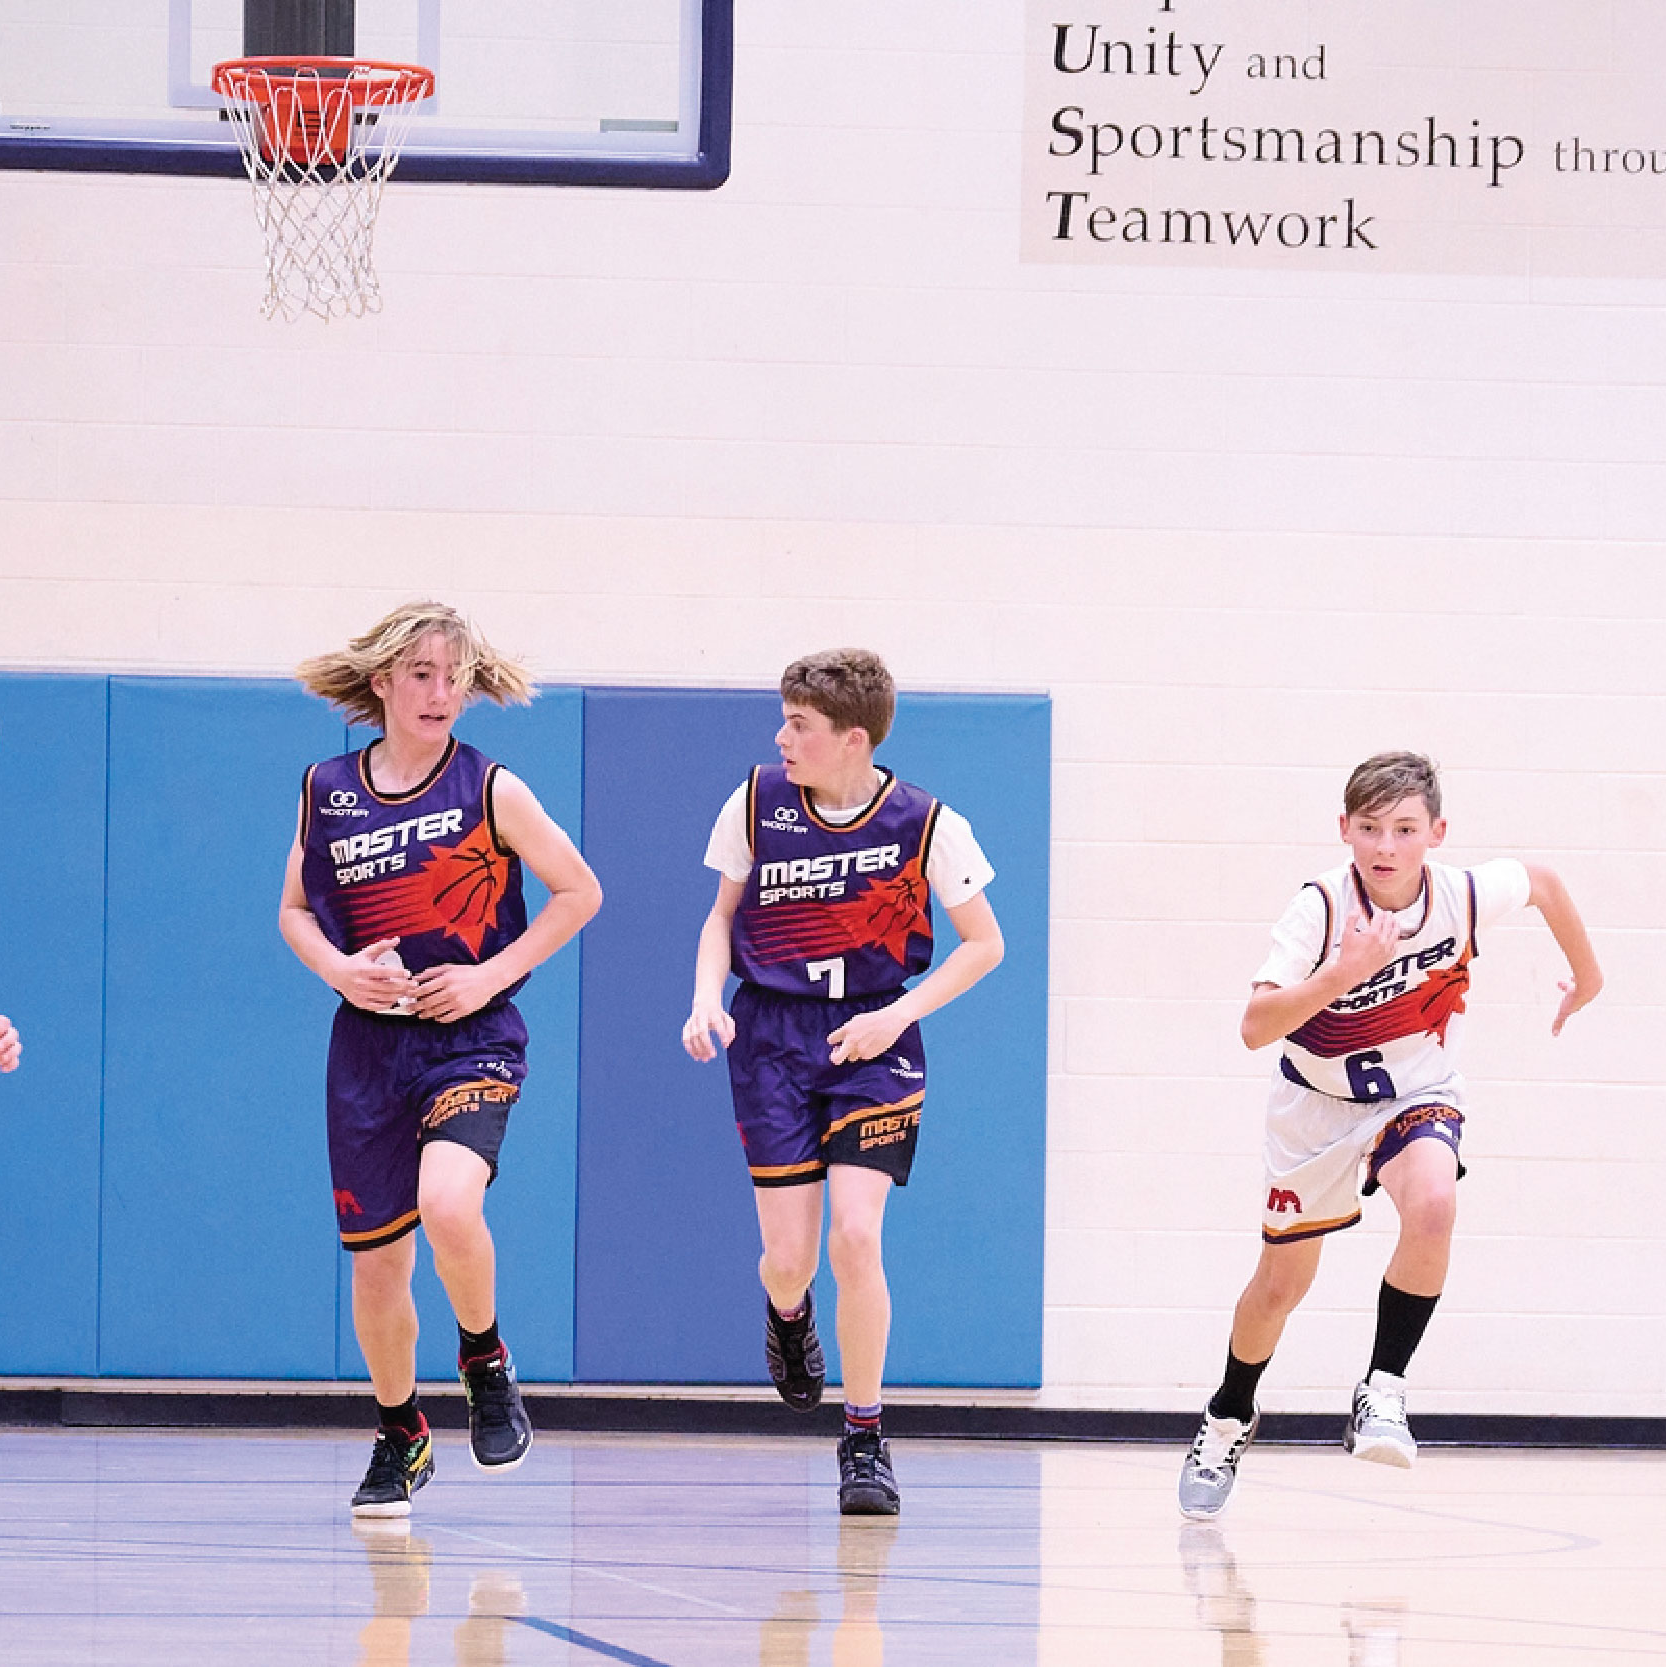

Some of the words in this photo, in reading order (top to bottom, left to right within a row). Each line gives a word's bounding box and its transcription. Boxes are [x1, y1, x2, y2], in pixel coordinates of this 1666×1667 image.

[1051, 22, 1226, 97] Unity
[1247, 43, 1327, 80] and
[1047, 105, 1525, 189] Sportsmanship
[1045, 190, 1379, 251] Teamwork
[329, 808, 464, 865] MASTER
[760, 843, 901, 886] MASTER
[759, 880, 848, 906] SPORTS
[805, 956, 846, 999] 7
[1345, 1050, 1397, 1101] 6
[859, 1109, 922, 1138] MASTE
